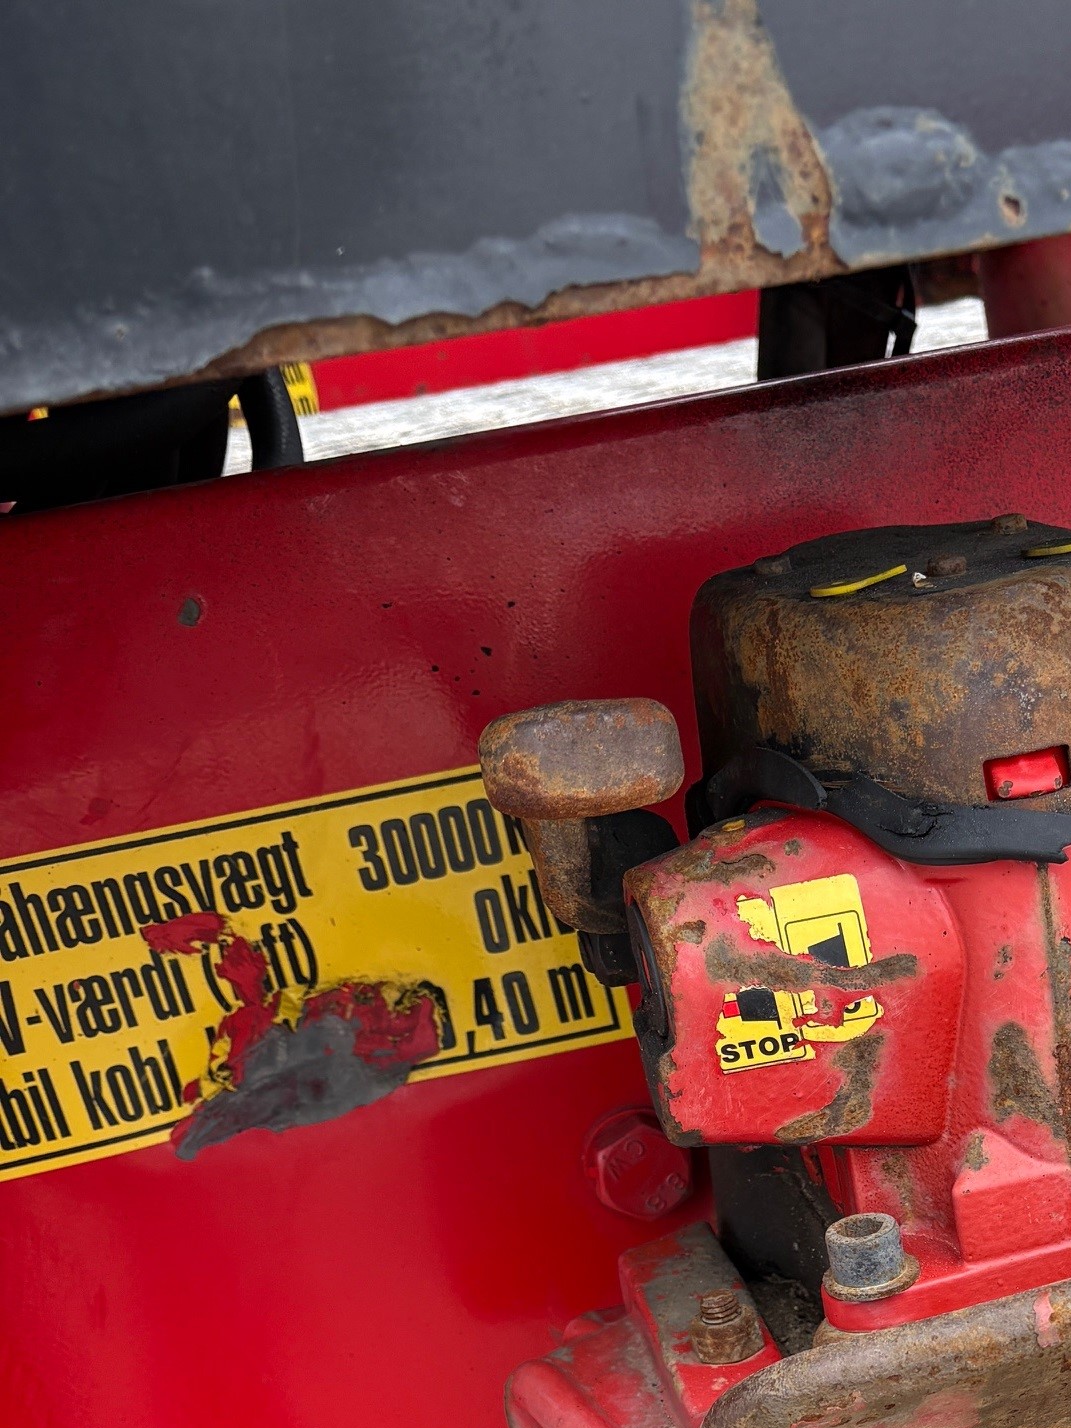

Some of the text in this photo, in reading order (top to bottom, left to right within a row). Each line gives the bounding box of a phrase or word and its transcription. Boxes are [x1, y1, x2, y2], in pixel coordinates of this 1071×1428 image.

[0, 1067, 72, 1151] bil
[70, 1038, 183, 1131] kobl
[546, 963, 596, 1023] m
[720, 1032, 800, 1063] STOP
